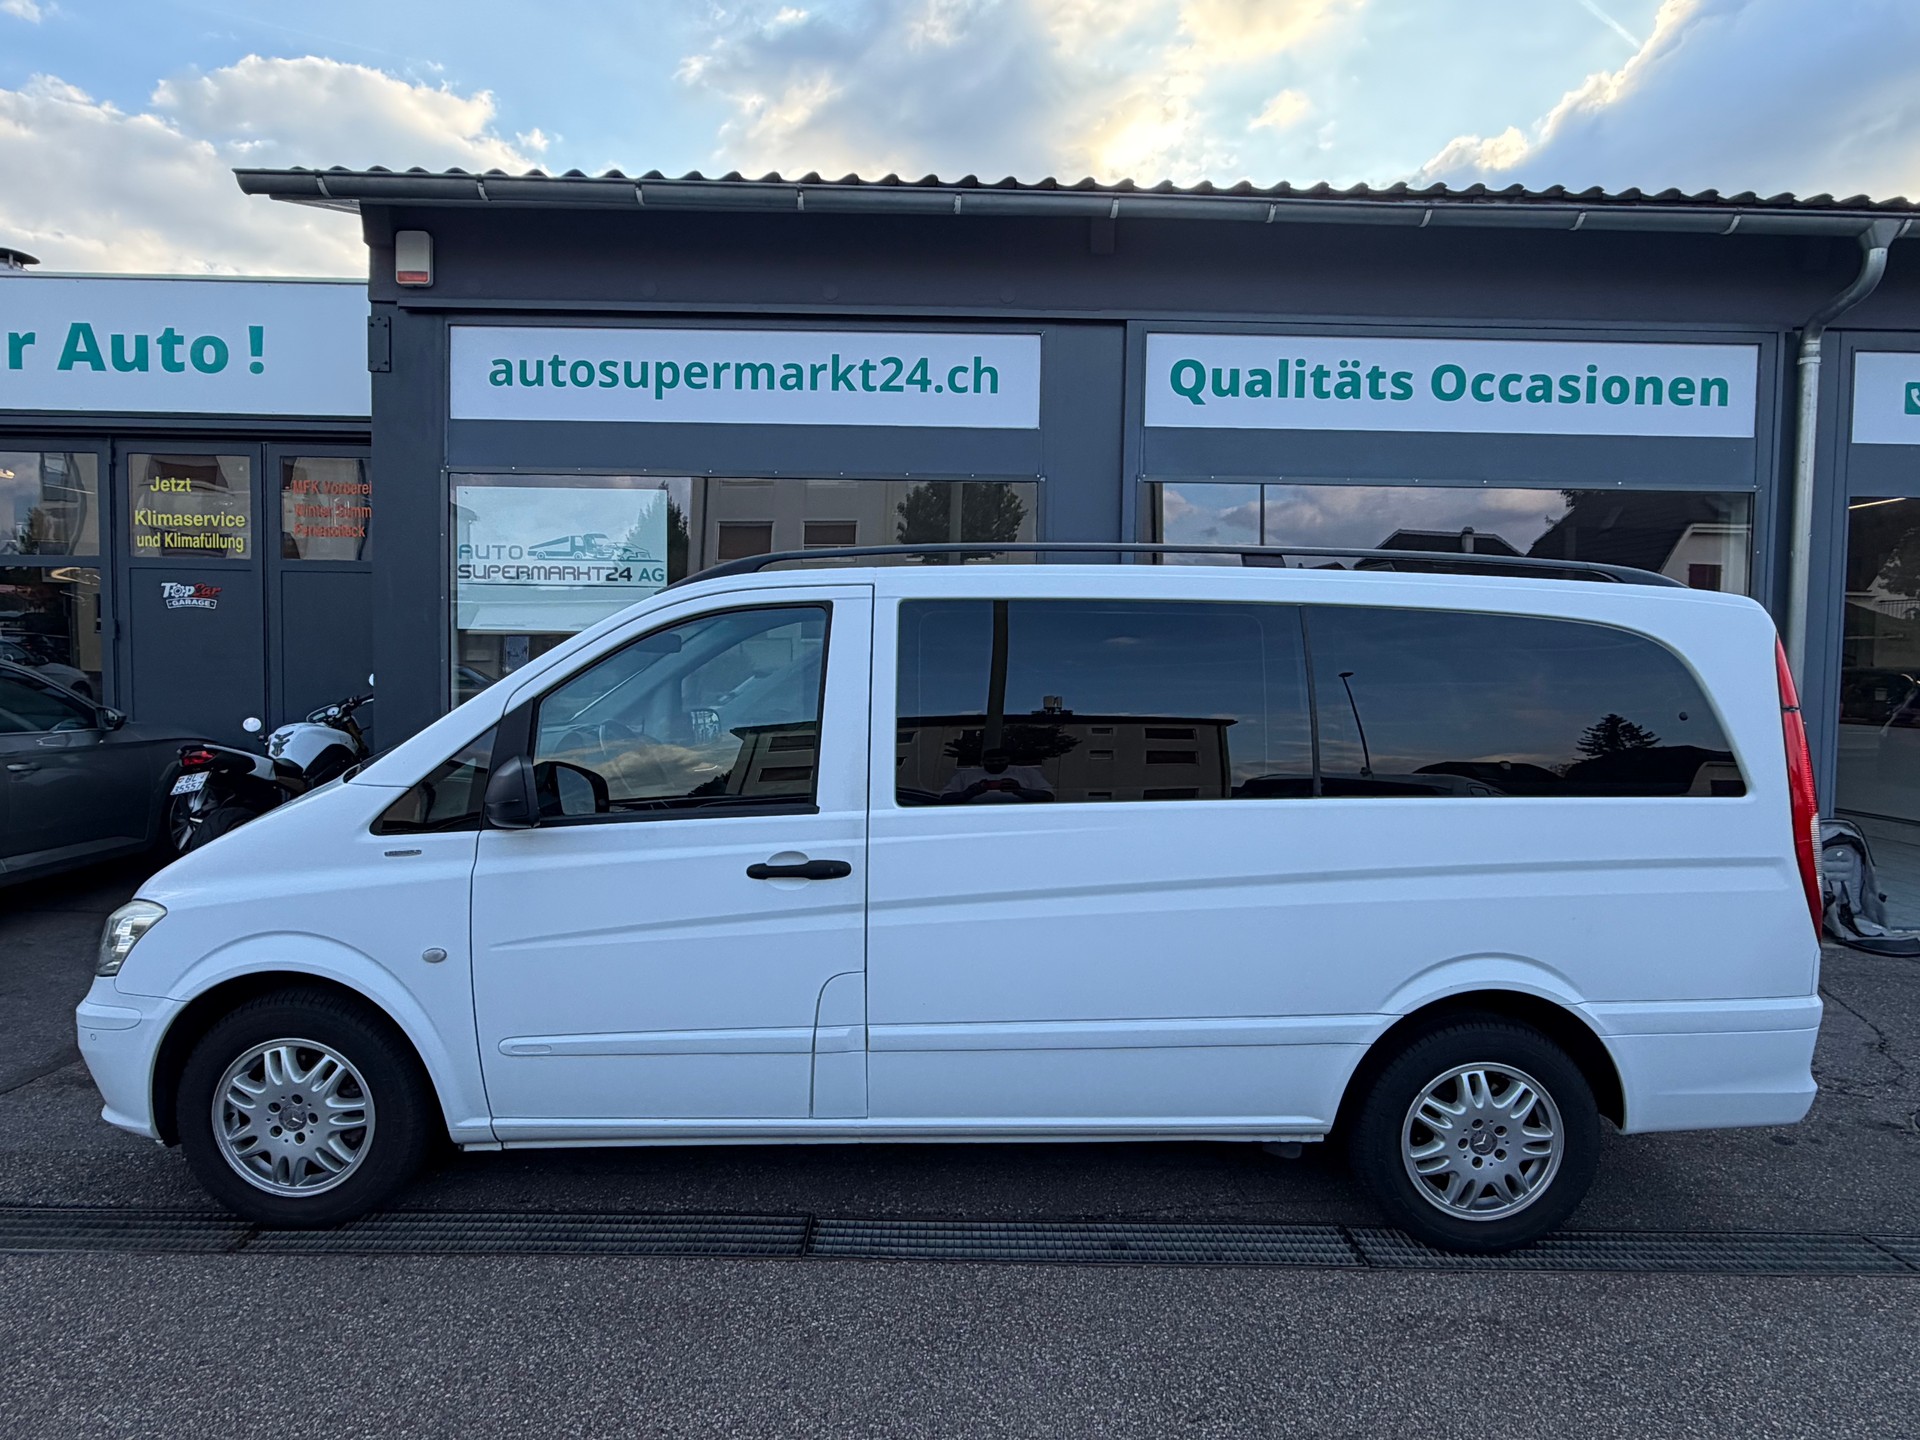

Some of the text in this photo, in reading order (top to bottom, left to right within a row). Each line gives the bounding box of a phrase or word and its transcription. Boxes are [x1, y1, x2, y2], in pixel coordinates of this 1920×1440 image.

[57, 322, 229, 374] Auto
[488, 354, 1000, 400] autosupermarkt24.ch
[1169, 358, 1729, 407] Qualitäts Occasionen
[150, 476, 192, 493] Jetzt
[134, 510, 246, 528] Klimaservice
[136, 532, 244, 552] und Klimafüllung
[458, 544, 524, 560] AUTO
[458, 564, 665, 582] SUPERMARKT24 AG
